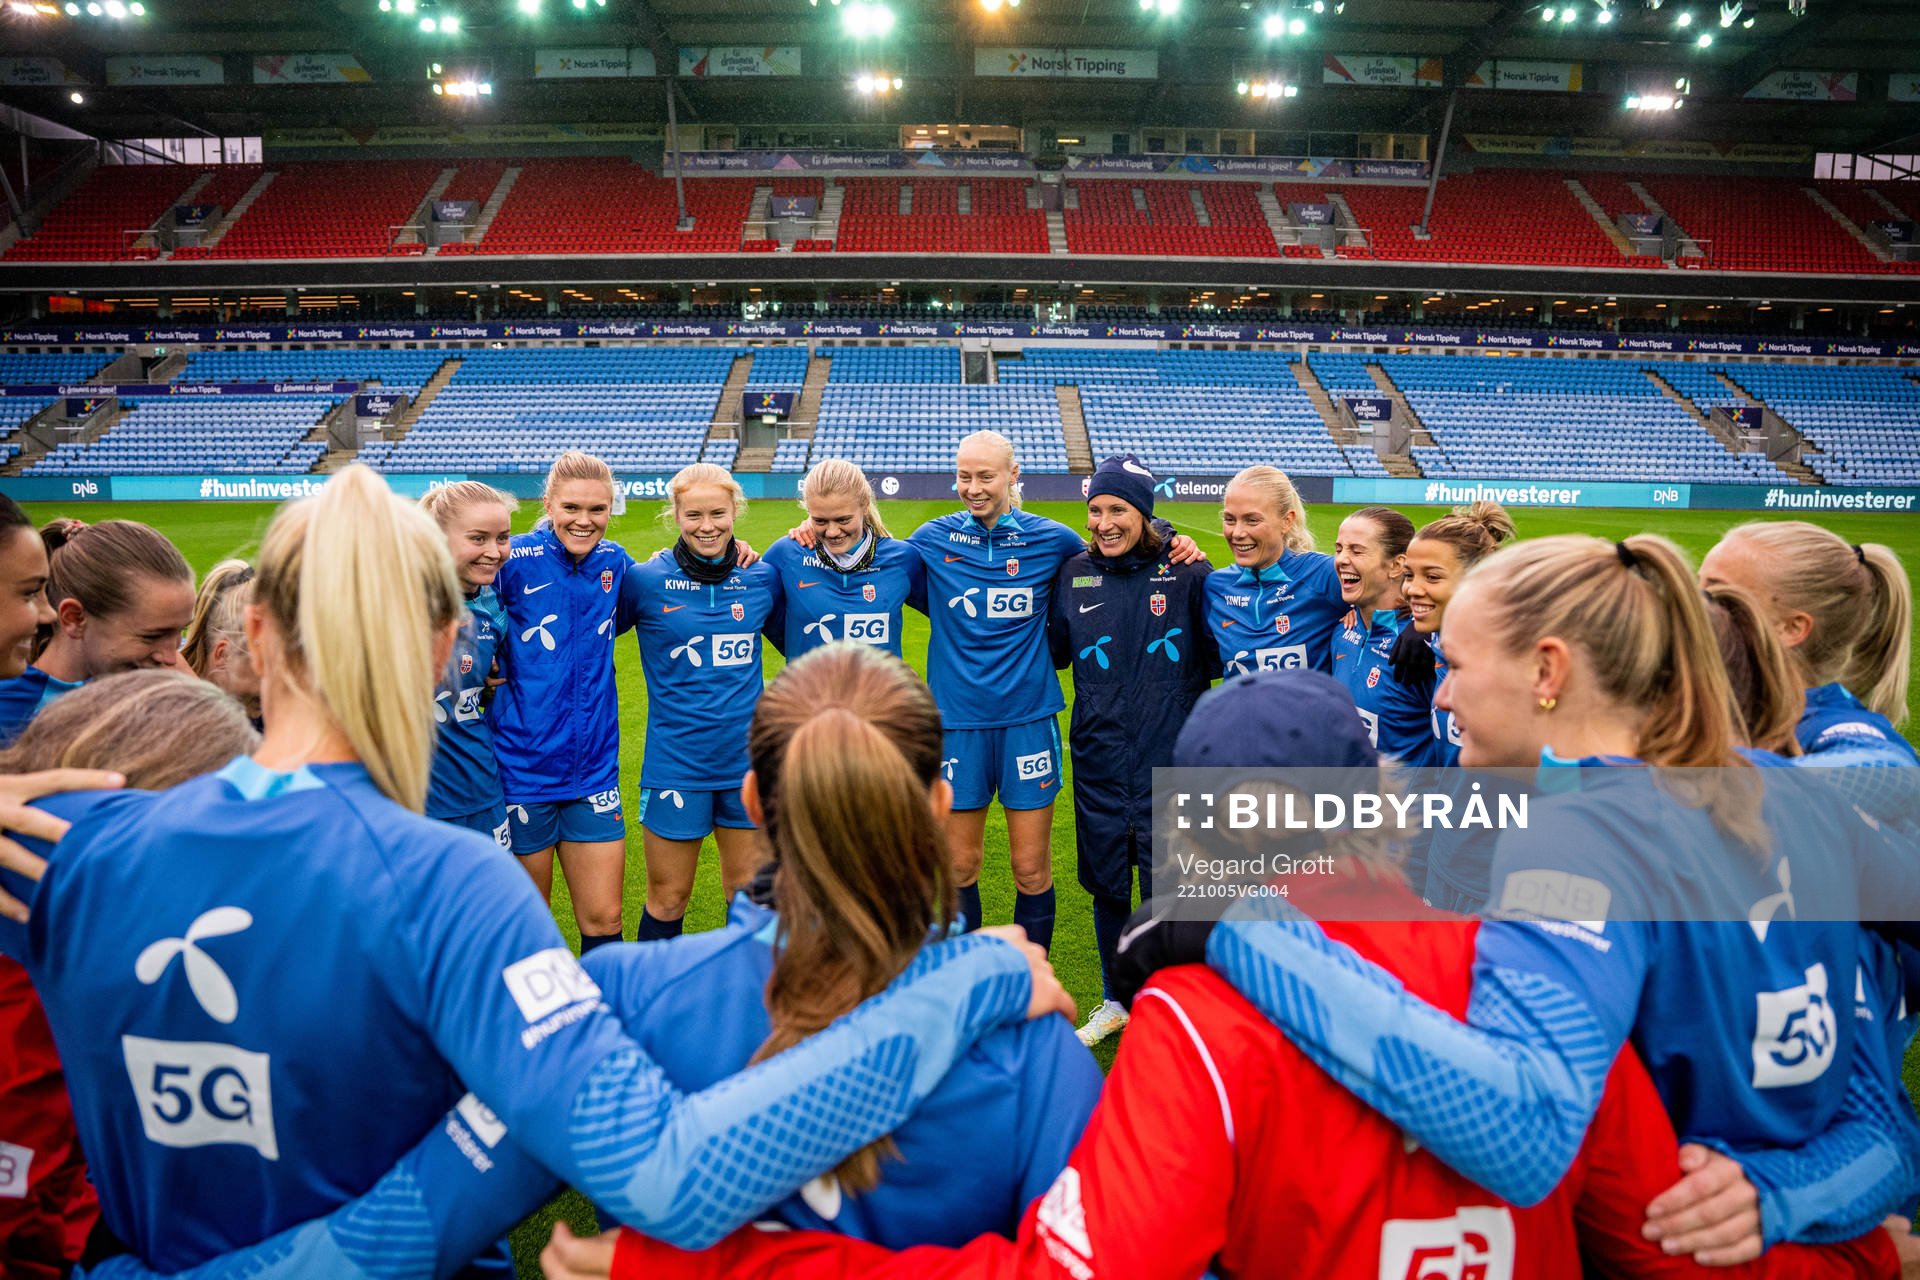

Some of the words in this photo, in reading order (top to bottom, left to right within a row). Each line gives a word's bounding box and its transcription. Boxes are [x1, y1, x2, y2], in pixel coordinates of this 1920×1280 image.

[573, 60, 597, 68] Norsk
[598, 59, 632, 69] Tipping
[1031, 57, 1072, 71] Norsk
[1074, 57, 1126, 74] Tipping
[143, 68, 168, 76] Norsk
[169, 68, 201, 78] Tipping
[1503, 72, 1528, 81] Norsk
[1529, 72, 1560, 83] Tipping
[696, 157, 719, 165] Norsk
[720, 157, 748, 167] Tipping
[966, 157, 989, 165] Norsk
[990, 158, 1018, 167] Tipping
[1125, 160, 1153, 169] Tipping
[1389, 166, 1418, 176] Tipping
[246, 331, 270, 340] Tipping
[298, 330, 317, 338] Norsk
[318, 330, 342, 339] Tipping
[390, 329, 414, 338] Tipping
[463, 328, 487, 337] Tipping
[516, 327, 535, 335] Norsk
[536, 327, 561, 337] Tipping
[609, 326, 635, 336] Tipping
[684, 326, 710, 335] Tipping
[760, 326, 785, 335] Tipping
[836, 326, 861, 335] Tipping
[911, 326, 937, 336] Tipping
[988, 327, 1013, 336] Tipping
[1043, 327, 1063, 335] Norsk
[1063, 328, 1089, 337] Tipping
[1140, 329, 1165, 338] Tipping
[1215, 330, 1240, 339] Tipping
[1289, 331, 1313, 340] Tipping
[14, 333, 33, 341] Norsk
[34, 333, 58, 342] Tipping
[105, 332, 129, 342] Tipping
[175, 331, 199, 341] Tipping
[1343, 332, 1362, 340] Norsk
[1363, 333, 1387, 342] Tipping
[1436, 334, 1460, 344] Tipping
[1508, 337, 1532, 346] Tipping
[1579, 339, 1602, 348] Tipping
[1648, 341, 1672, 350] Tipping
[1719, 342, 1742, 352] Tipping
[1788, 344, 1811, 354] Tipping
[1858, 346, 1880, 355] Tipping
[198, 386, 221, 394] Tipping
[72, 479, 98, 498] DNB
[1175, 478, 1225, 496] telenor
[1425, 483, 1581, 504] #huninvesterer
[1653, 486, 1679, 505] DNB
[1765, 488, 1915, 508] #huninvesterer
[949, 531, 970, 544] KIWI
[509, 546, 533, 560] KIWI
[665, 579, 689, 590] KIWI
[992, 593, 1028, 613] 5G
[1224, 595, 1242, 607] KIWI
[849, 619, 885, 639] 5G
[718, 639, 750, 660] 5G
[1263, 652, 1301, 673] 5G
[1022, 756, 1048, 775] 5G
[596, 789, 618, 807] 5G
[1513, 878, 1596, 915] DNB
[150, 1062, 253, 1126] 5G
